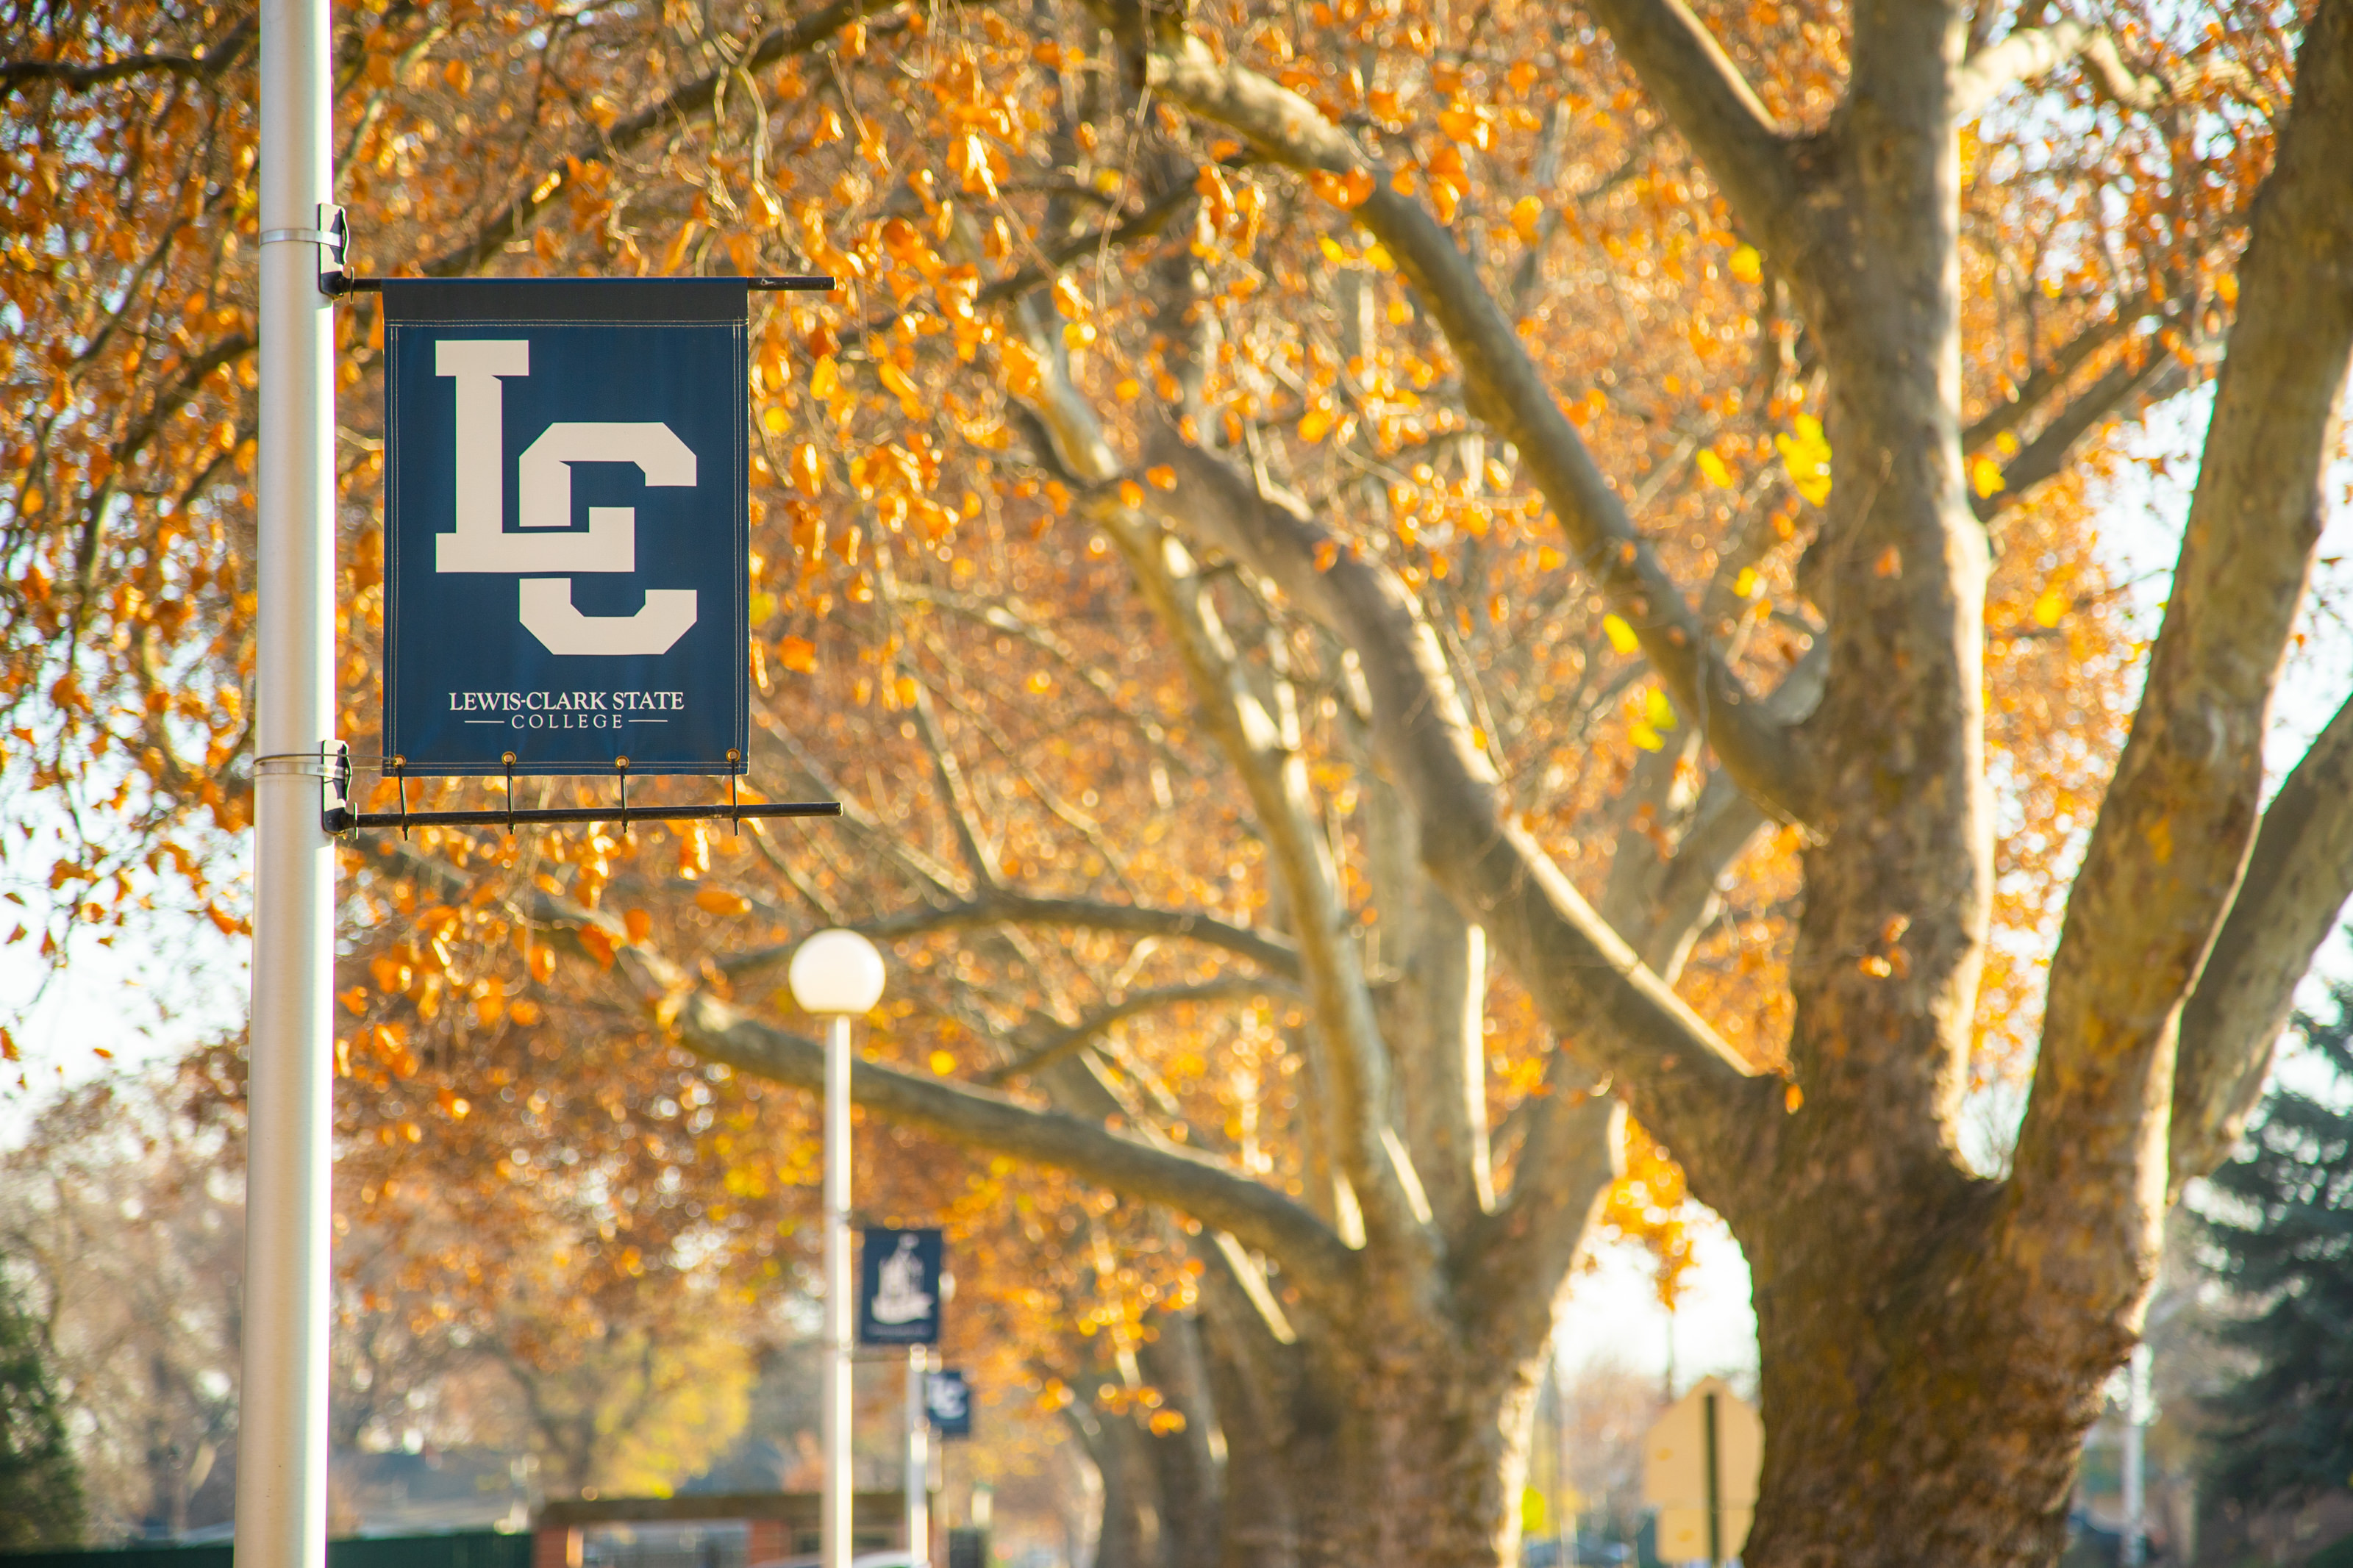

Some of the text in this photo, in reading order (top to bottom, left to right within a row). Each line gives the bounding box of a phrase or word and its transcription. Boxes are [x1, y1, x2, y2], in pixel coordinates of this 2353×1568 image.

[435, 340, 697, 655] LC
[449, 691, 685, 711] LEWIS-CLARK STATE
[511, 714, 623, 729] COLLEGE
